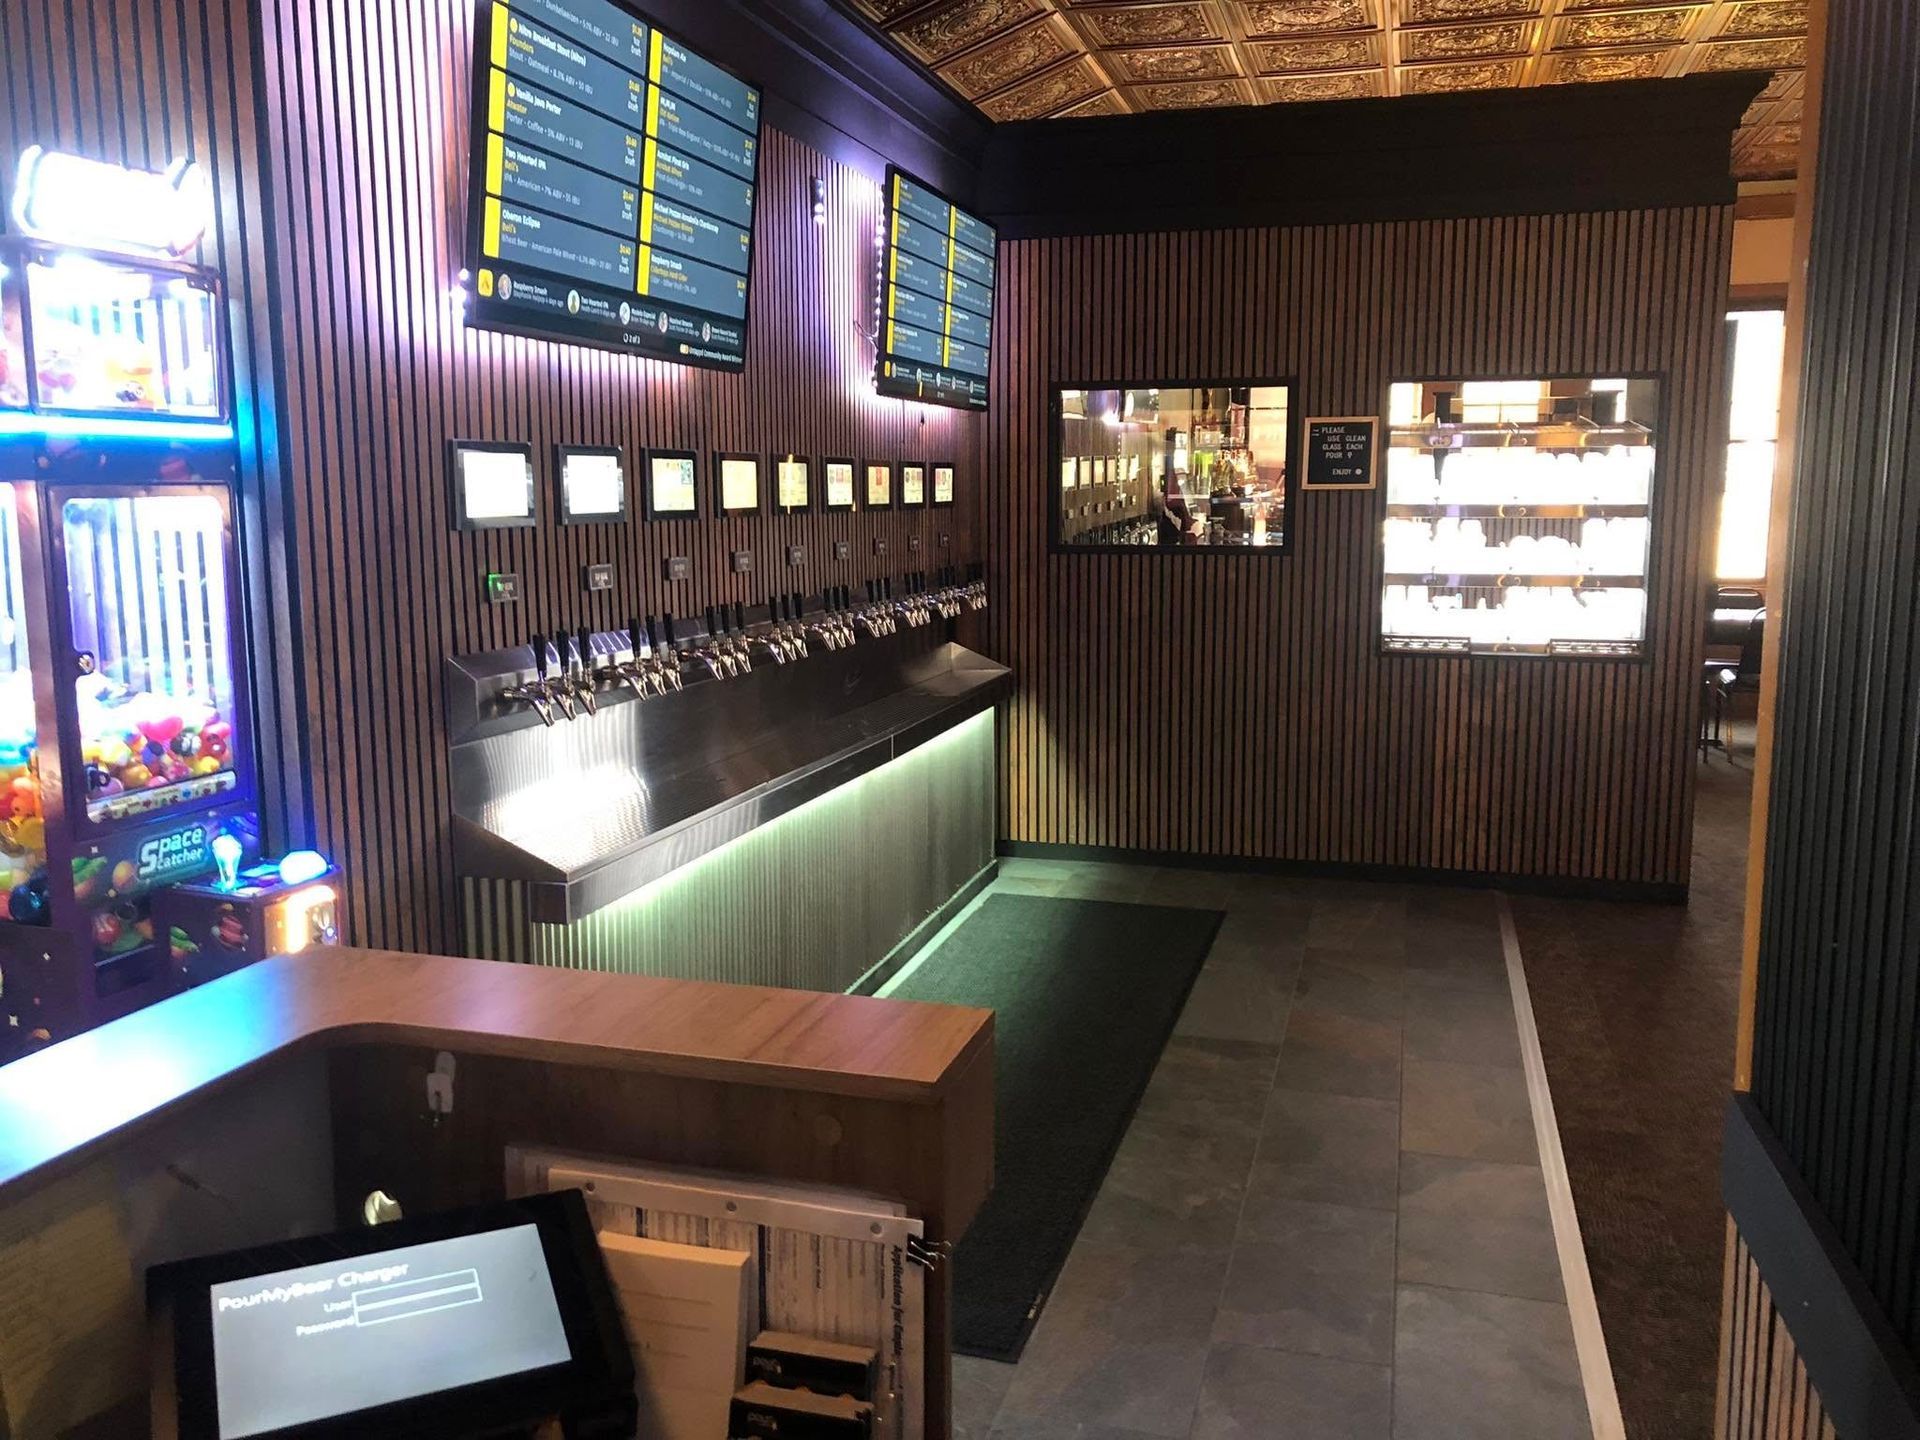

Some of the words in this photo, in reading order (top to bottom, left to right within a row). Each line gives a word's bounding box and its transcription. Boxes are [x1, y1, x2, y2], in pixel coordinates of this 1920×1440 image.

[140, 828, 202, 875] Space
[219, 1278, 334, 1312] PourMyBeer
[338, 1264, 409, 1288] Charger
[890, 1244, 904, 1306] Application
[890, 1306, 905, 1322] for
